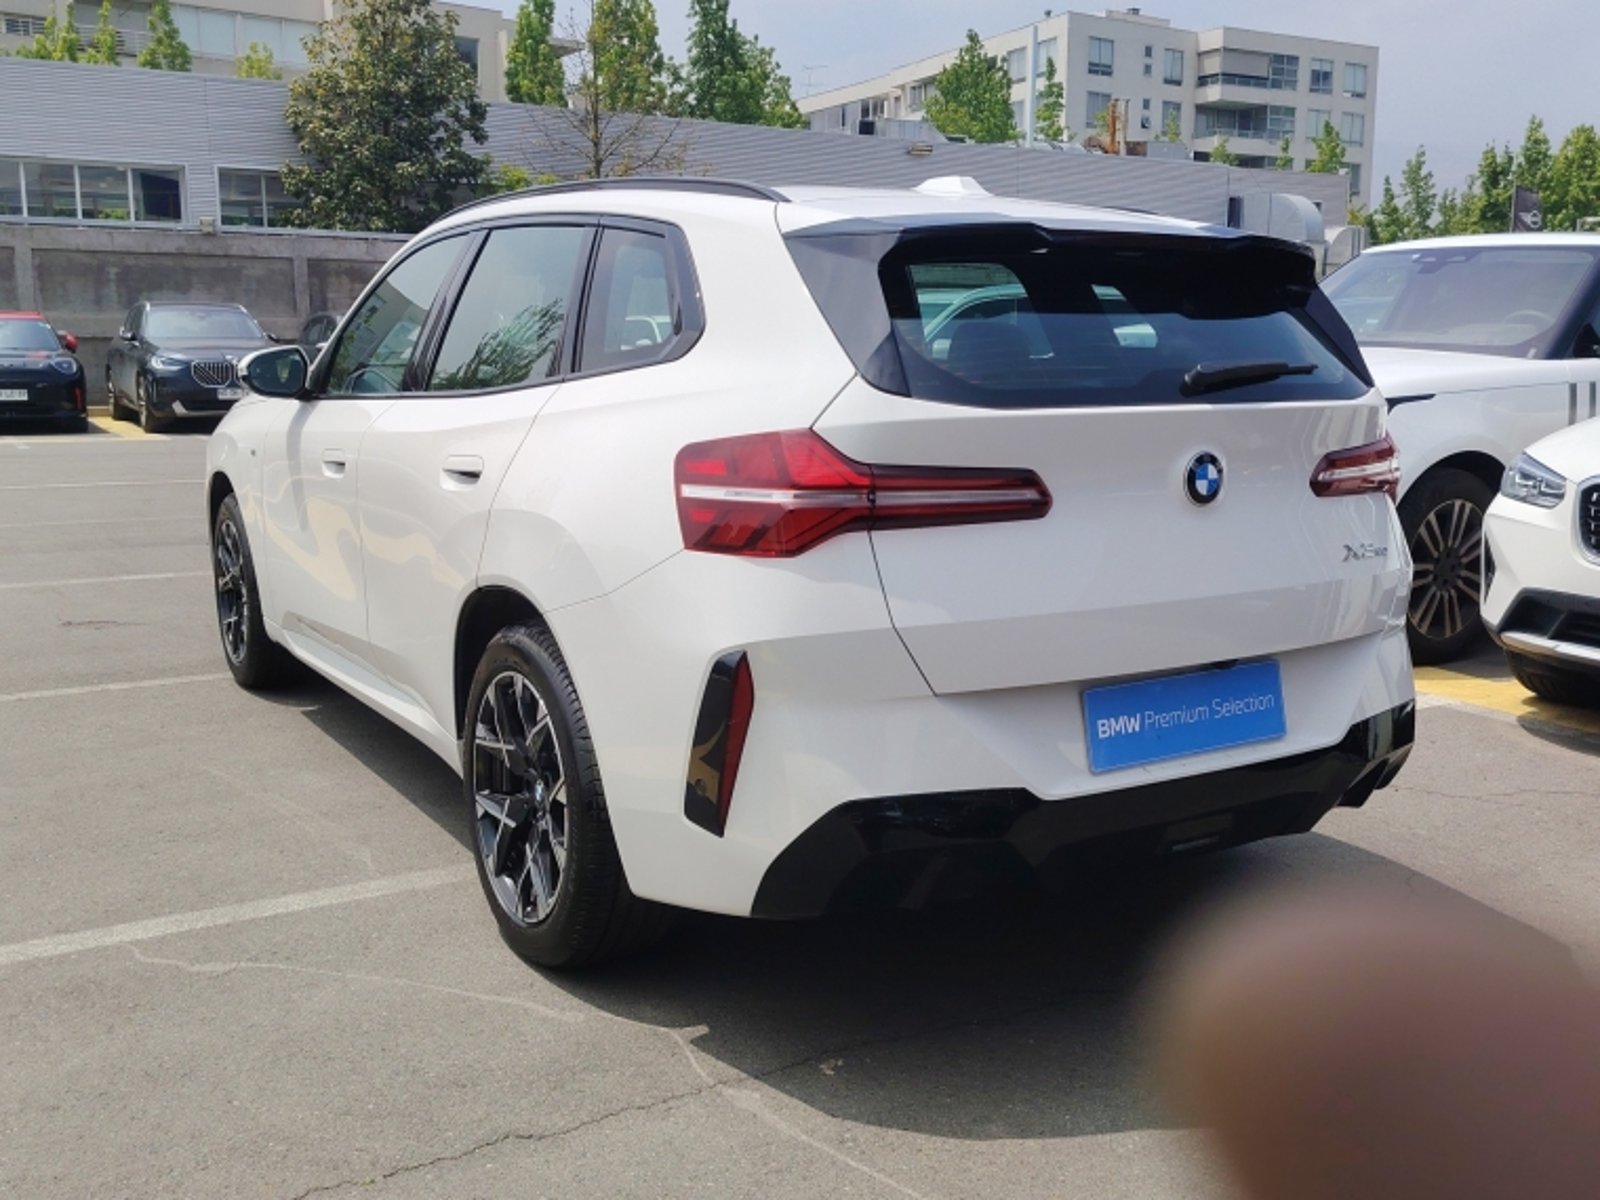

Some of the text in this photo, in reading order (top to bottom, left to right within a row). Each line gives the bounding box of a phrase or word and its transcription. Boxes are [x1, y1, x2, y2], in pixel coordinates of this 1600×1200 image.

[1097, 693, 1275, 738] BMW Premium Selection
